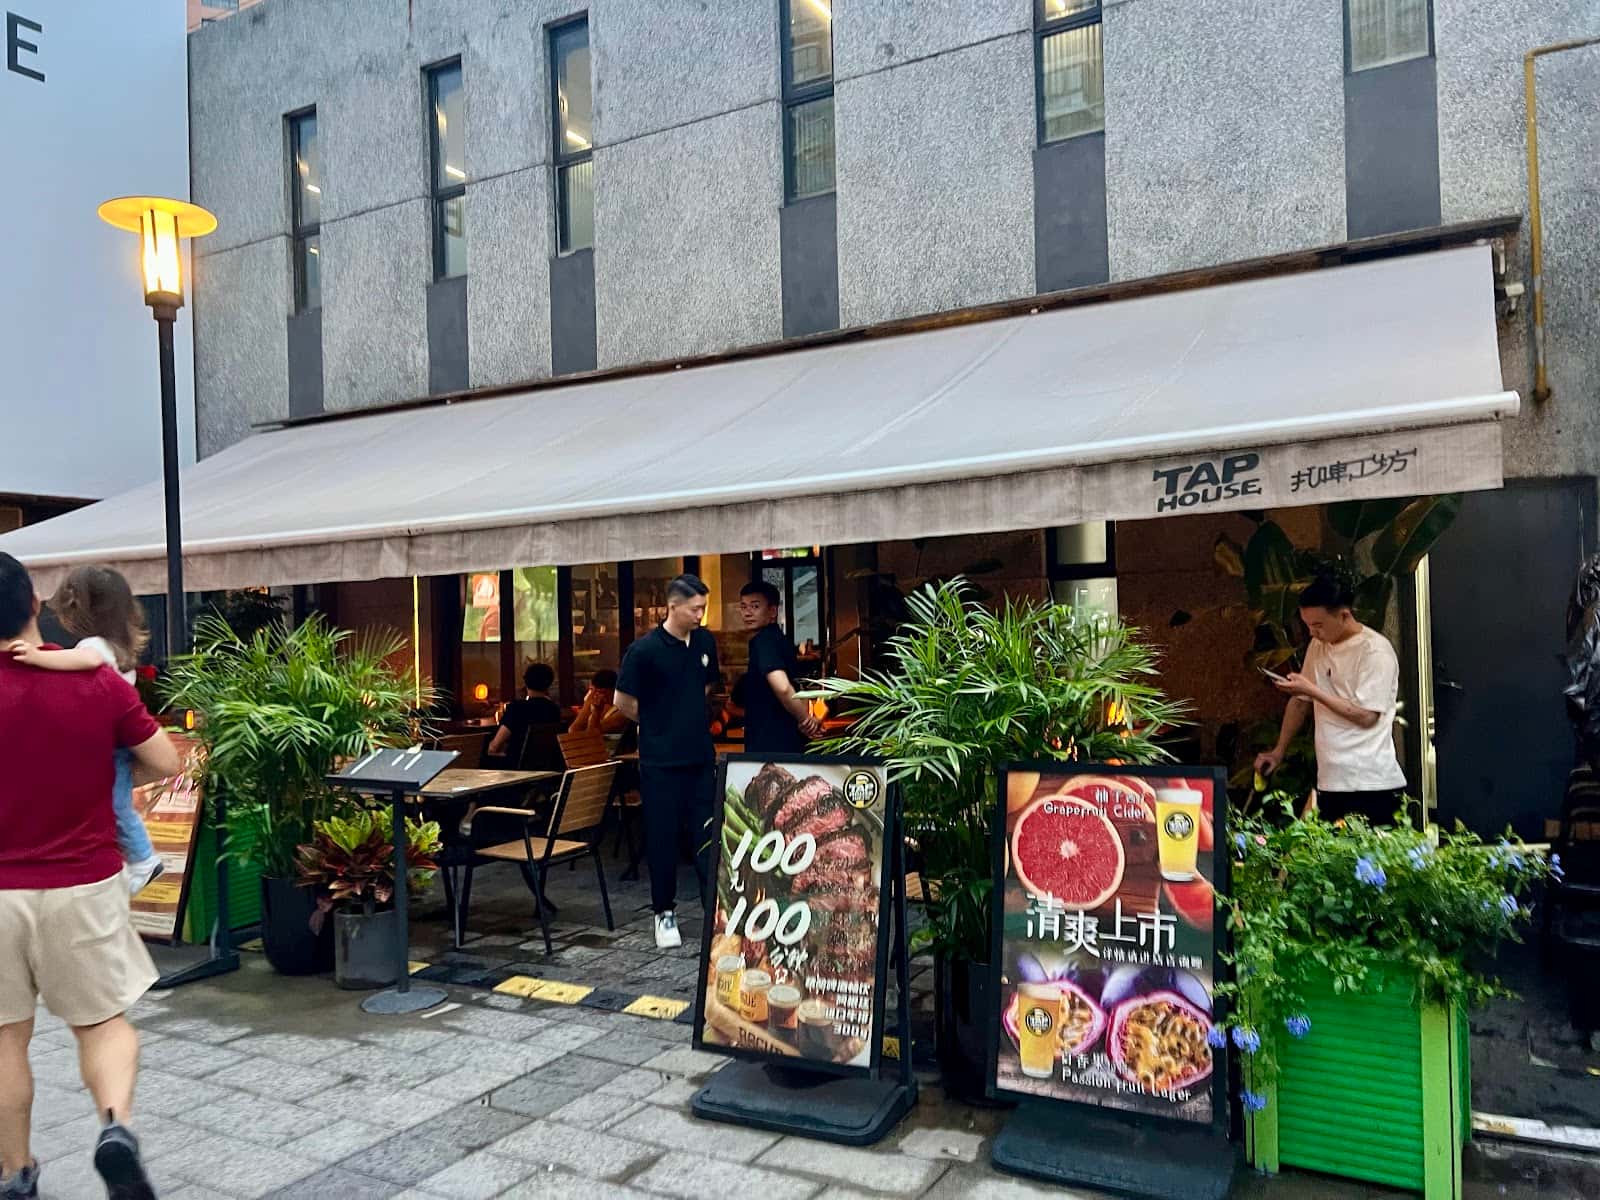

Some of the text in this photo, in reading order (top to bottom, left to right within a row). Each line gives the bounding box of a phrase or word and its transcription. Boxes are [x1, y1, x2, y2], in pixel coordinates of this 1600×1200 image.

[7, 11, 45, 83] E
[1153, 453, 1260, 496] TAP
[1157, 478, 1262, 513] HOUSE
[731, 829, 817, 876] 100
[725, 896, 812, 946] 100
[1025, 891, 1178, 958] 清爽上市
[1062, 1066, 1111, 1089] Passion
